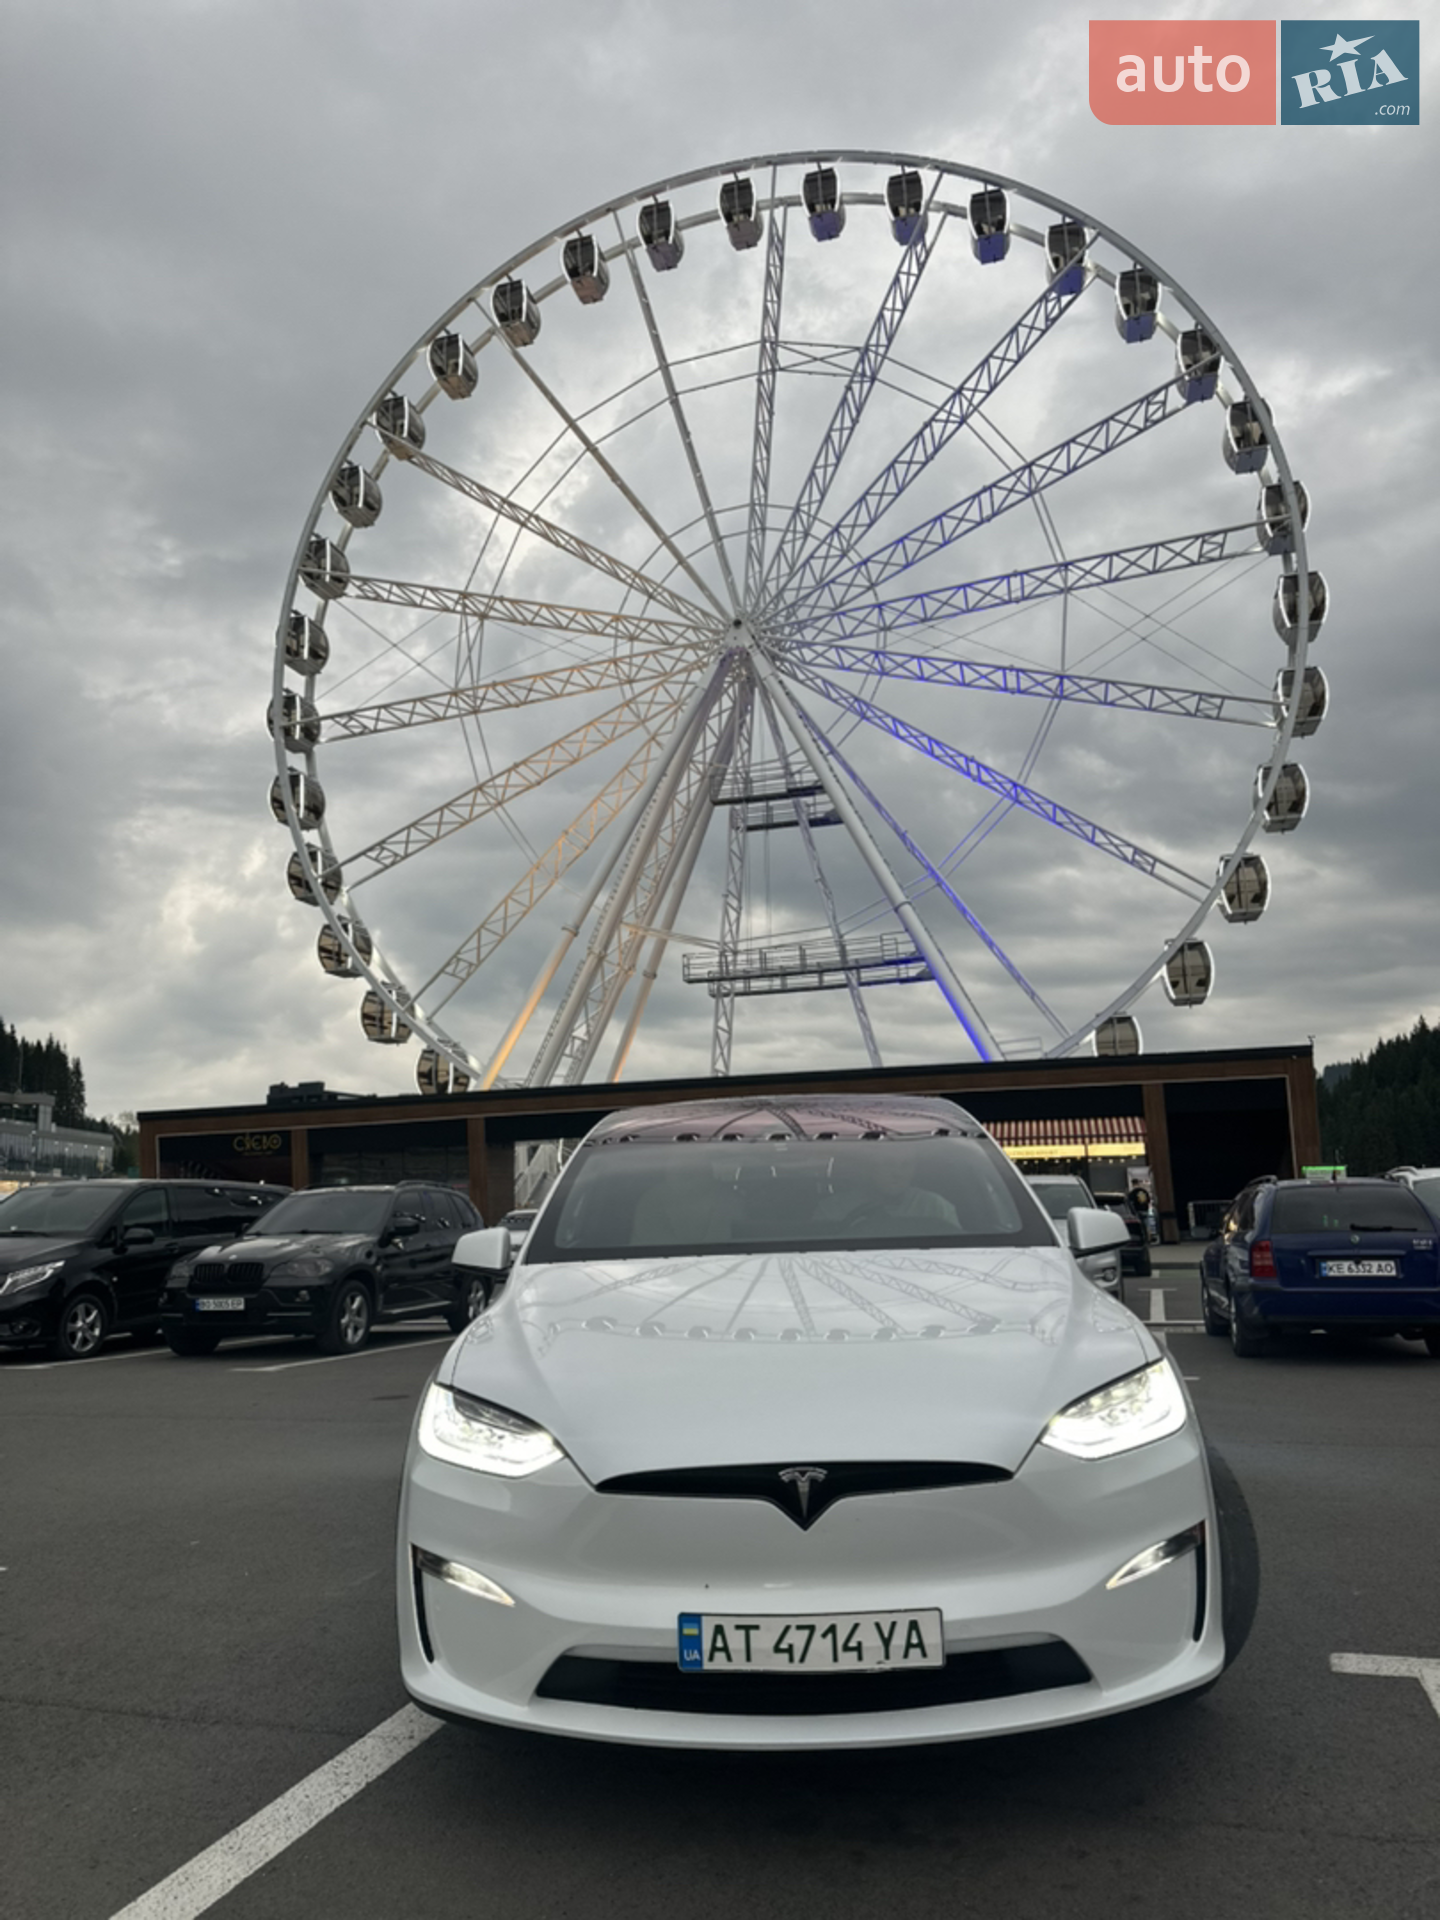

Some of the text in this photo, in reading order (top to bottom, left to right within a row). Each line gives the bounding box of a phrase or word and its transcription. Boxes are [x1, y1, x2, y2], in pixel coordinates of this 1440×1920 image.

[684, 1649, 701, 1661] UA
[708, 1619, 928, 1663] AT 4714 YA
